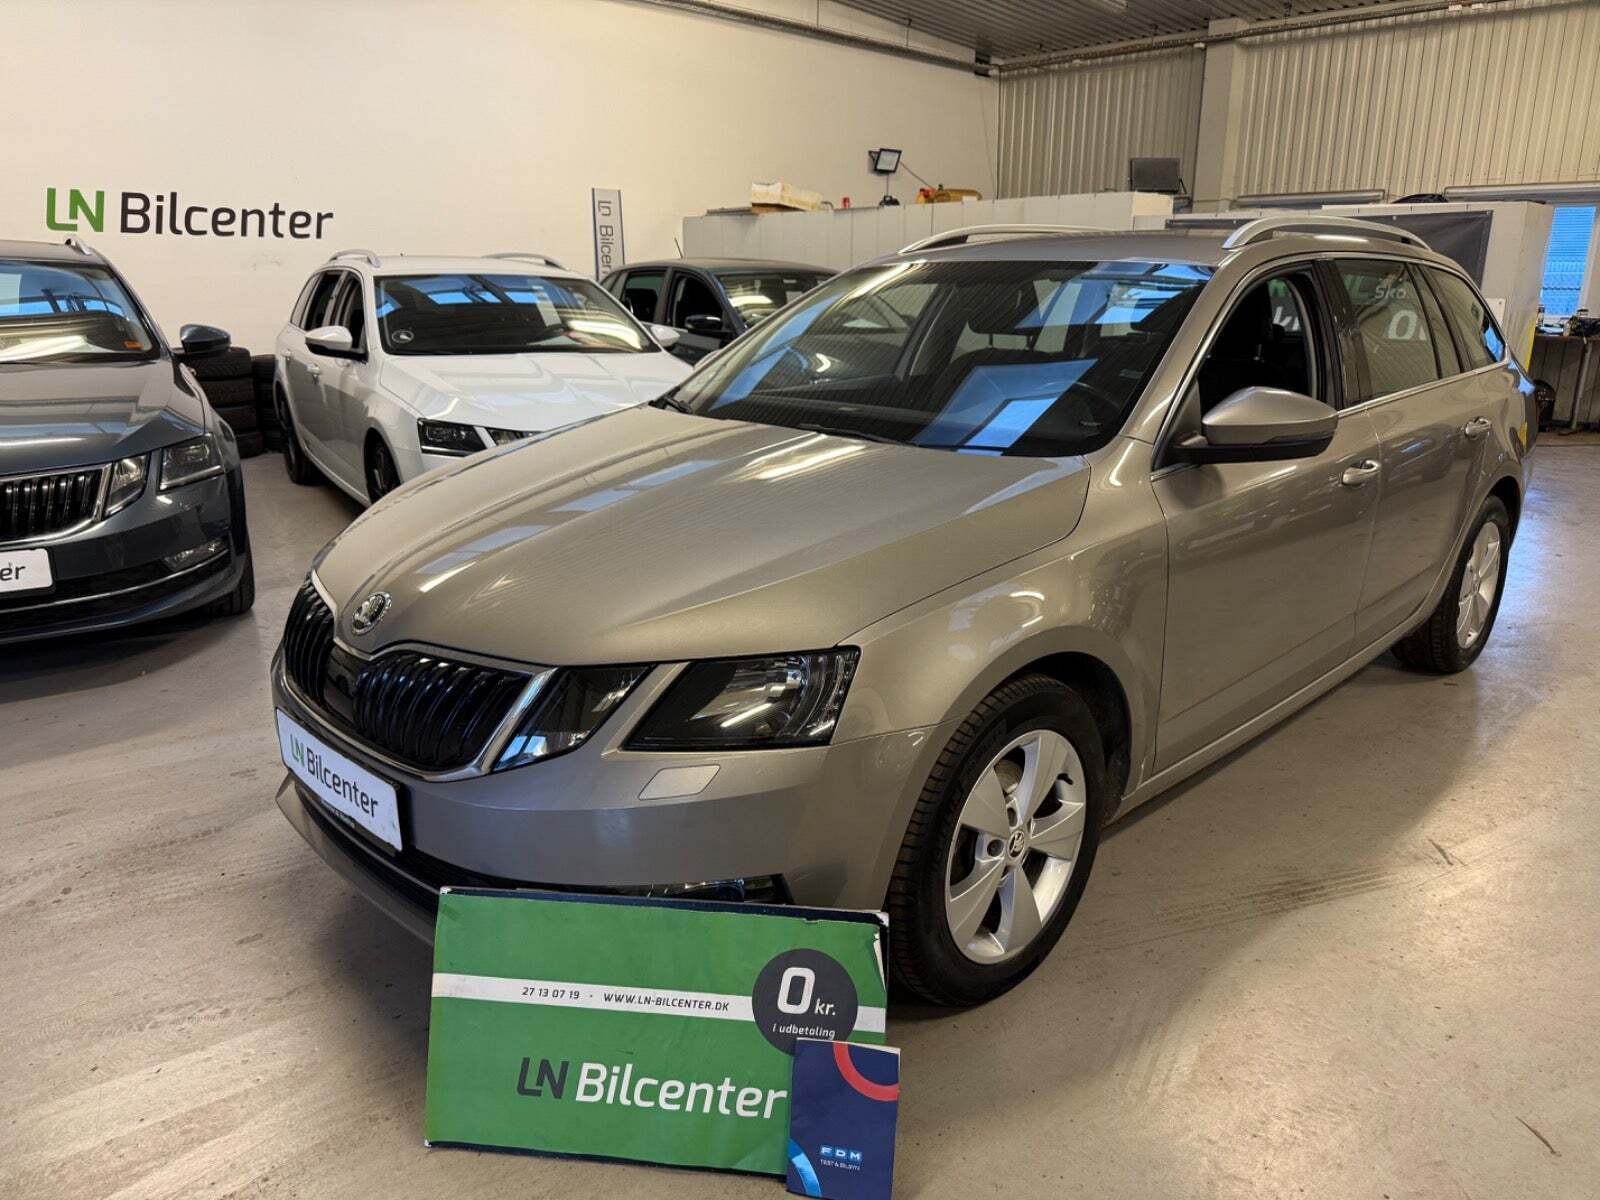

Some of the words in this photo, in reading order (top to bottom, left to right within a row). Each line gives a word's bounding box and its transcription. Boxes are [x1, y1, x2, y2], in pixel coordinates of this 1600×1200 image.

[46, 187, 105, 232] LN
[120, 191, 334, 239] Bilcenter
[290, 734, 305, 767] LN
[306, 747, 378, 818] Bilcenter
[522, 987, 535, 996] 27
[538, 988, 549, 997] 13
[552, 989, 565, 998] 07
[569, 990, 580, 999] 19
[604, 993, 730, 1012] WWW.LN-BILCENTER.DK
[777, 967, 816, 1015] 0
[814, 998, 836, 1016] kr.
[779, 1024, 836, 1040] udbetaling
[516, 1057, 570, 1100] LN
[575, 1062, 788, 1119] Bilcenter
